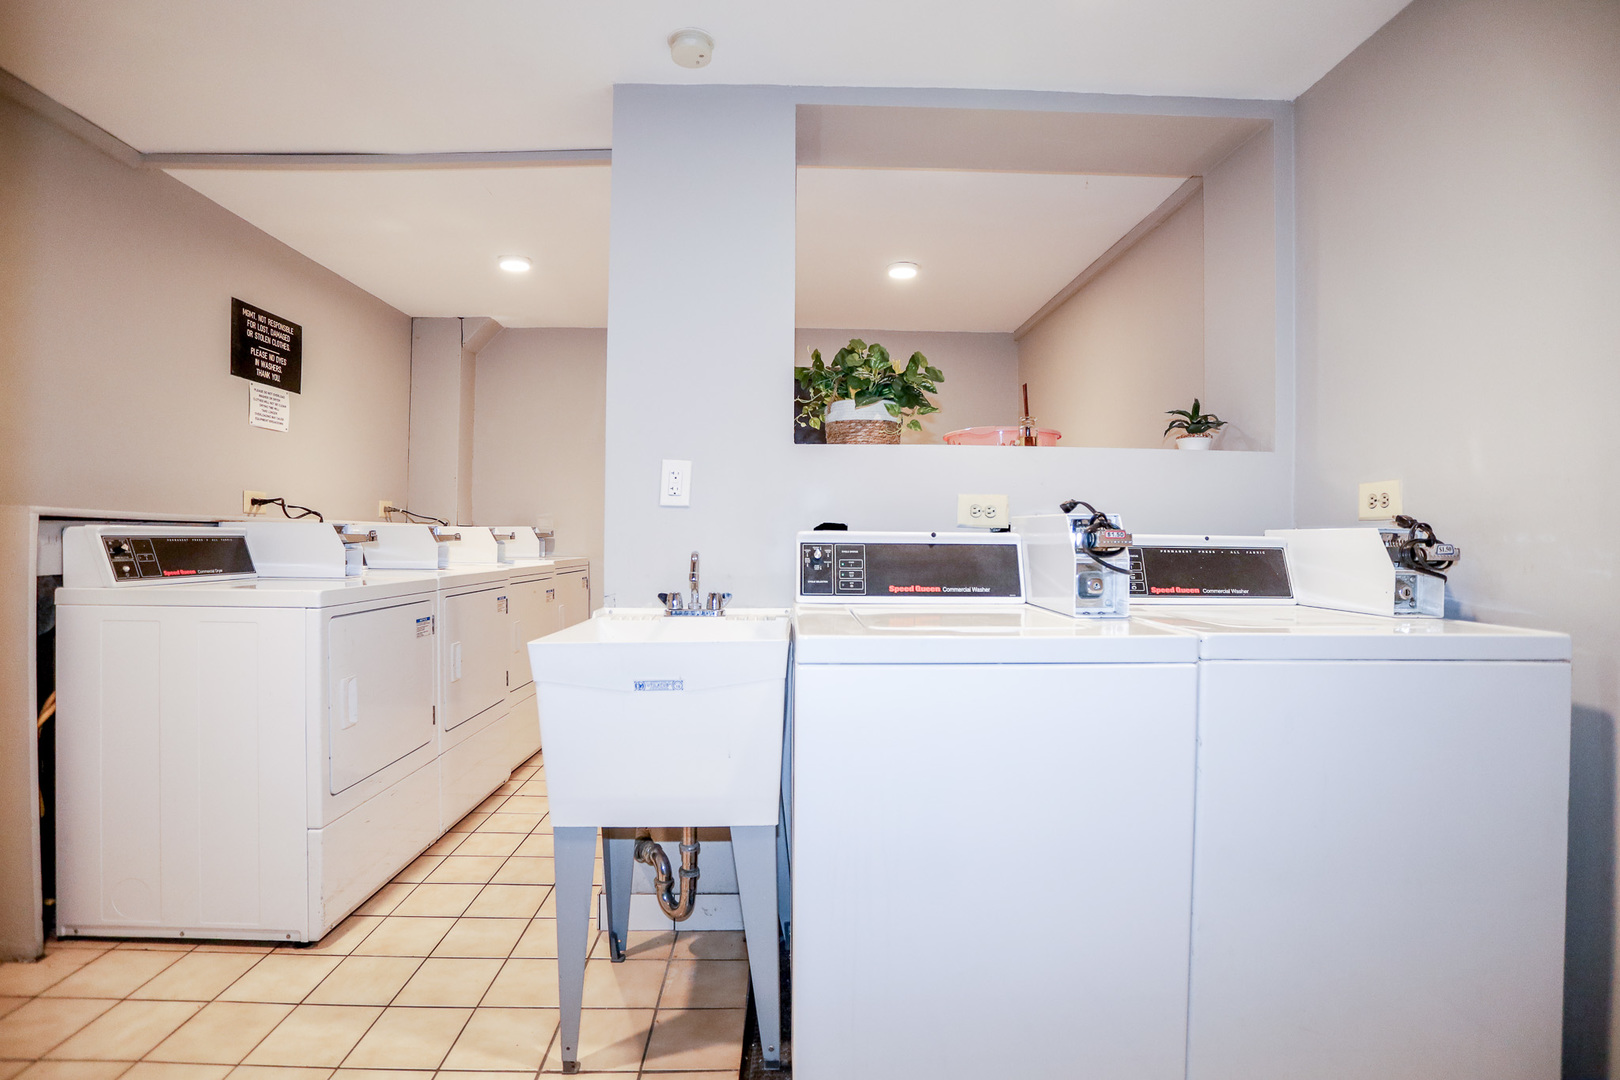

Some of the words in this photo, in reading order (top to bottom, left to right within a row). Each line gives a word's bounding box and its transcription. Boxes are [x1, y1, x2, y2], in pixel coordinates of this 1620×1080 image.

[242, 308, 257, 320] MGMT.
[258, 314, 266, 324] NOT
[268, 318, 294, 335] RESPONSIBLE
[247, 320, 256, 329] FOR
[257, 323, 269, 335] LOST,
[270, 329, 290, 342] DAMAGED
[247, 329, 253, 338] OR
[255, 332, 271, 344] STOLEN
[272, 339, 290, 351] CLOTHES.
[251, 347, 268, 360] PLEASE
[261, 360, 282, 373] WASHERS.
[256, 368, 270, 379] THANK
[889, 585, 914, 593] Speed
[1151, 586, 1175, 594] Speed
